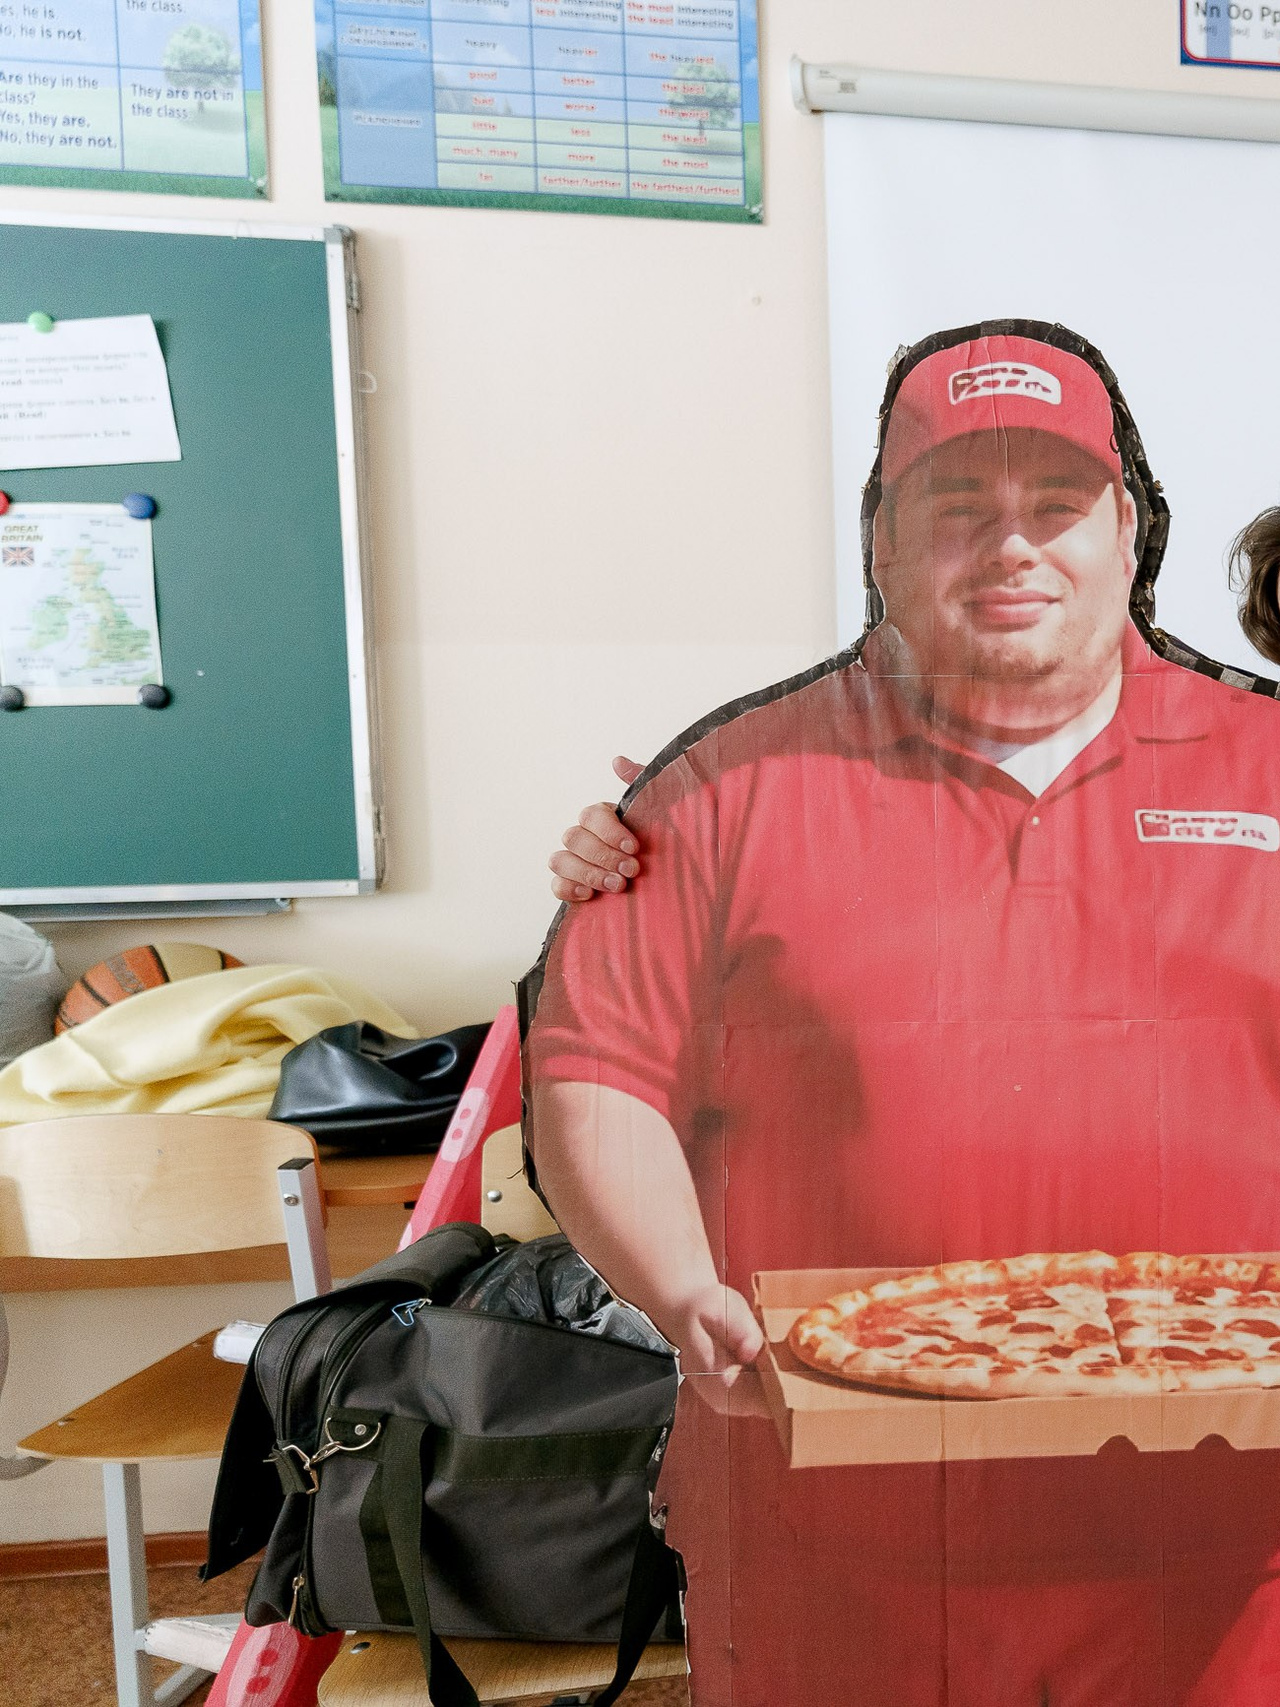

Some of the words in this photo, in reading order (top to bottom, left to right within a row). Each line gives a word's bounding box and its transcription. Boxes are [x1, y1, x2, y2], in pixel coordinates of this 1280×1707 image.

[0, 5, 19, 19] es,
[23, 3, 38, 17] he
[126, 0, 147, 11] the
[1194, 1, 1220, 18] Nn
[1228, 4, 1253, 20] Oo
[0, 23, 16, 39] o,
[20, 23, 36, 38] he
[41, 24, 52, 38] is
[0, 71, 22, 85] Are
[28, 71, 57, 90] they
[61, 73, 73, 88] in
[78, 75, 98, 90] the
[131, 83, 162, 100] They
[166, 89, 189, 101] are
[194, 89, 218, 101] not
[222, 90, 234, 101] in
[132, 103, 153, 117] the
[29, 112, 57, 128] they
[26, 131, 55, 148] they
[60, 136, 82, 148] are
[88, 137, 117, 150] not.
[4, 525, 39, 533] GREAT
